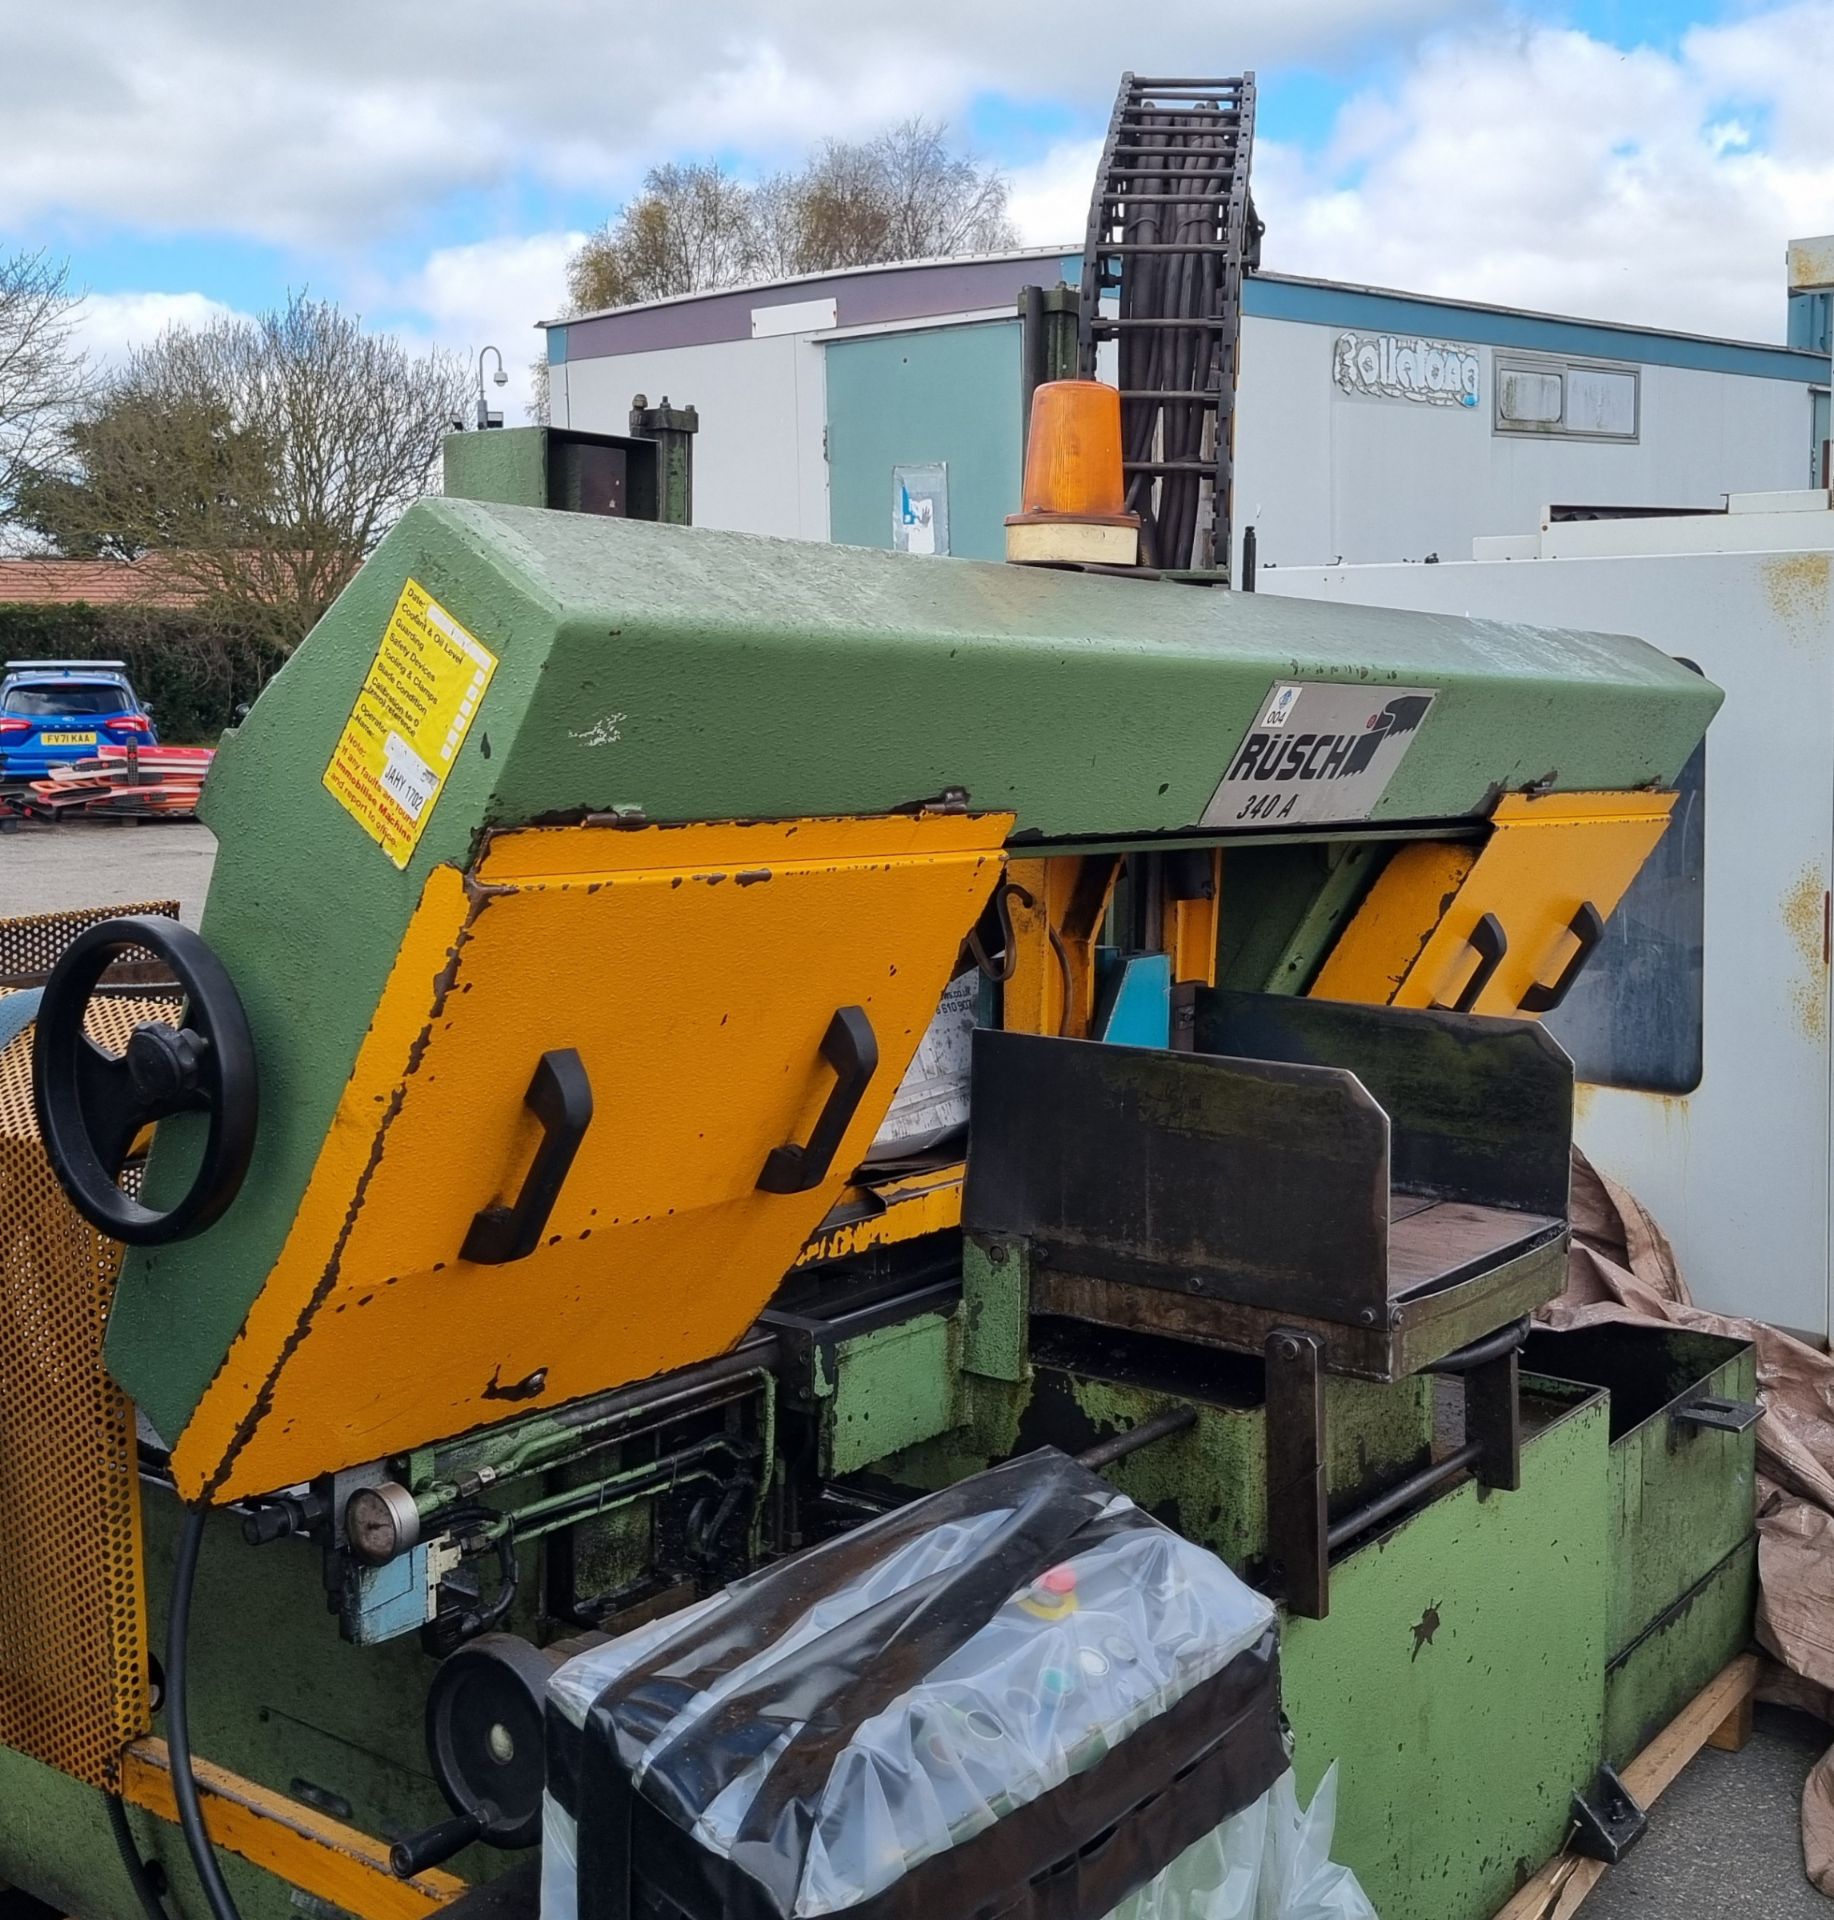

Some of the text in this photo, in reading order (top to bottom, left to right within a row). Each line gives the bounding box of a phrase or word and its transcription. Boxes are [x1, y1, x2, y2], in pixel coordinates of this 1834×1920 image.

[407, 588, 425, 609] Date:
[389, 632, 436, 682] Safety Devices
[396, 618, 424, 652] Guarding
[402, 603, 464, 665] Coolant & Oil Level
[378, 662, 428, 716] Blade Condition
[384, 647, 438, 704] Tooling & Clamps
[361, 704, 388, 734] Operator
[372, 677, 404, 715] Calibration
[404, 710, 413, 722] to
[386, 705, 416, 738] reference
[1267, 711, 1287, 724] 004
[71, 734, 90, 743] KAA
[347, 732, 366, 758] Note:
[1228, 734, 1357, 781] RÜSCH
[330, 772, 344, 790] and
[344, 788, 368, 814] report
[368, 811, 376, 822] to
[336, 758, 412, 842] Immobilise Machine
[348, 755, 360, 770] any
[361, 767, 381, 792] faults
[382, 792, 395, 806] are
[384, 764, 424, 812] JAHY 1702
[1236, 794, 1299, 819] 340 A
